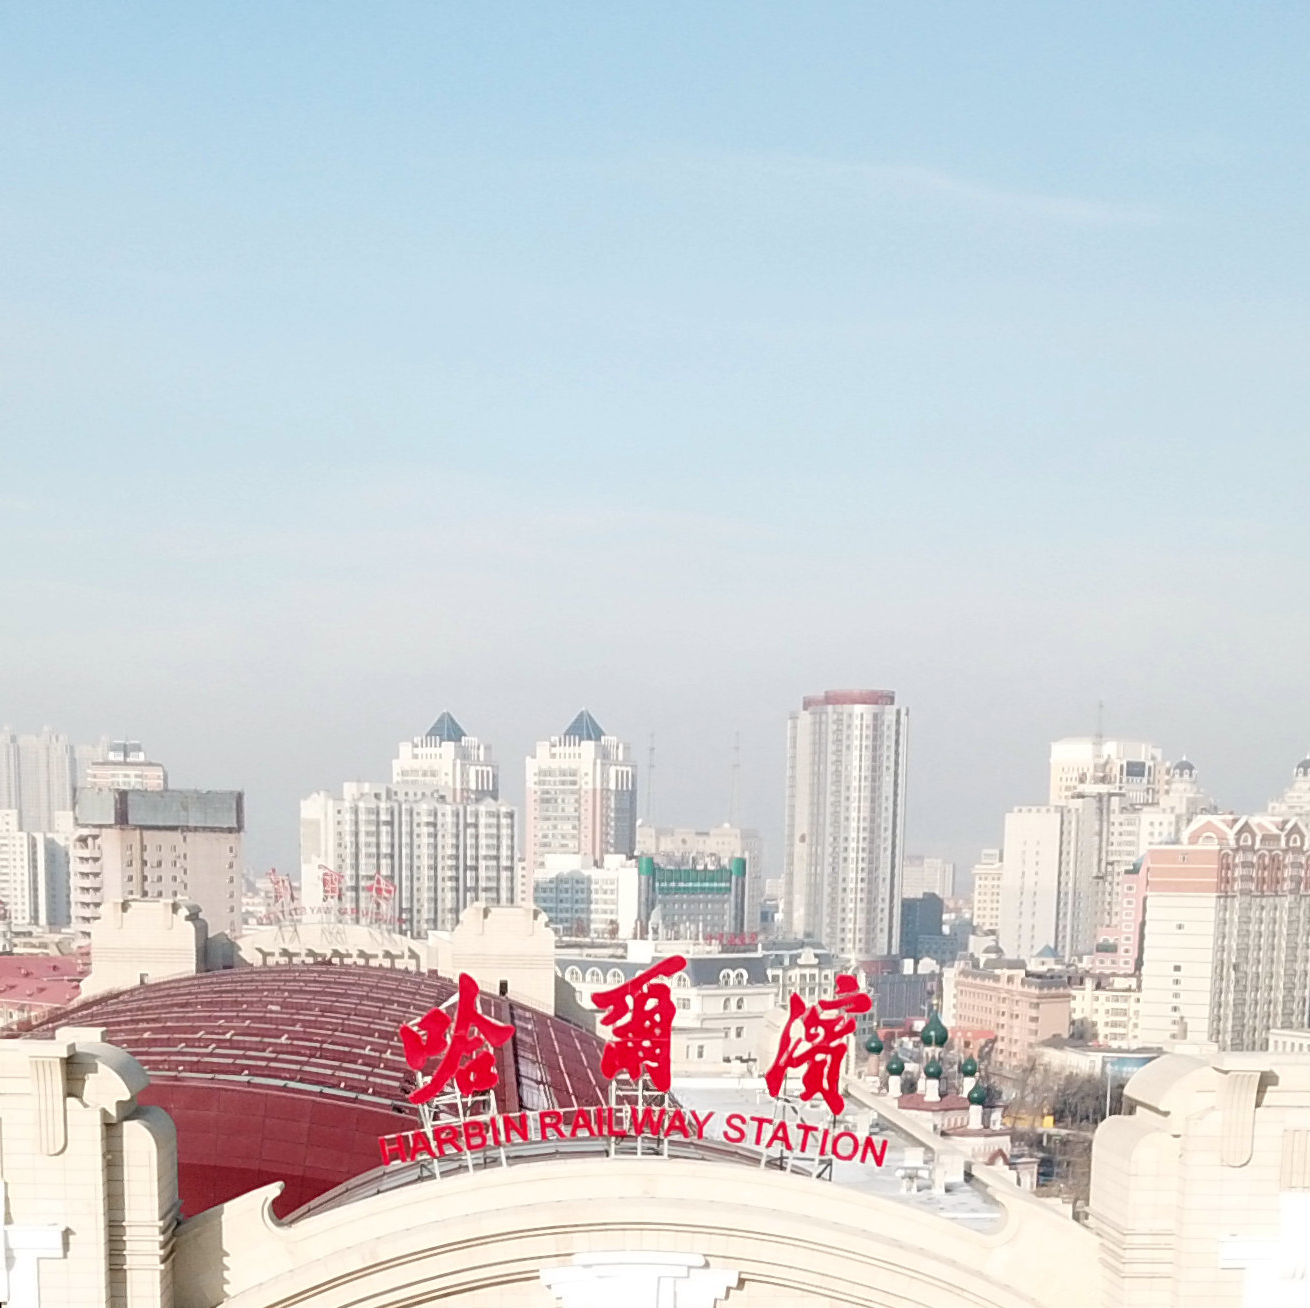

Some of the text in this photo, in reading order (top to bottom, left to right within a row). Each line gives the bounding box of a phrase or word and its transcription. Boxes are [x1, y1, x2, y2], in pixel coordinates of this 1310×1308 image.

[378, 1104, 888, 1167] HARBIN RAILWAY STATION
